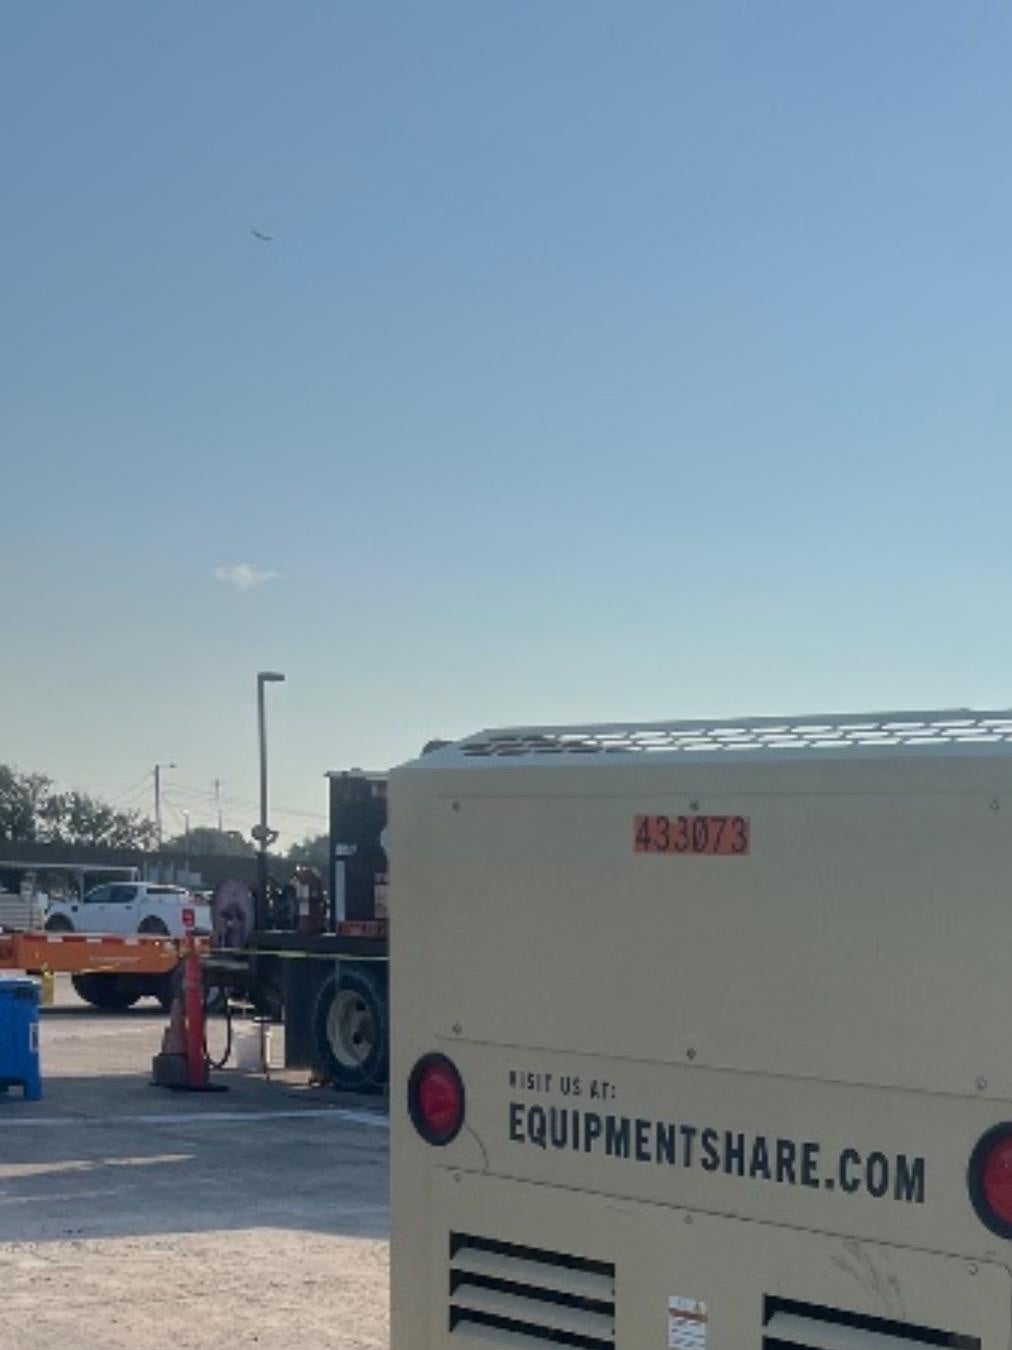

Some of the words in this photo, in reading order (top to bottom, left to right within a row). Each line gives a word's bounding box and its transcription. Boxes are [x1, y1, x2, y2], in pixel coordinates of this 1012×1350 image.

[635, 815, 748, 852] 433073
[509, 1070, 552, 1092] VISIT
[560, 1076, 582, 1096] US
[590, 1079, 616, 1099] AT:
[509, 1102, 926, 1203] EQUIPMENTSHARE.COM
